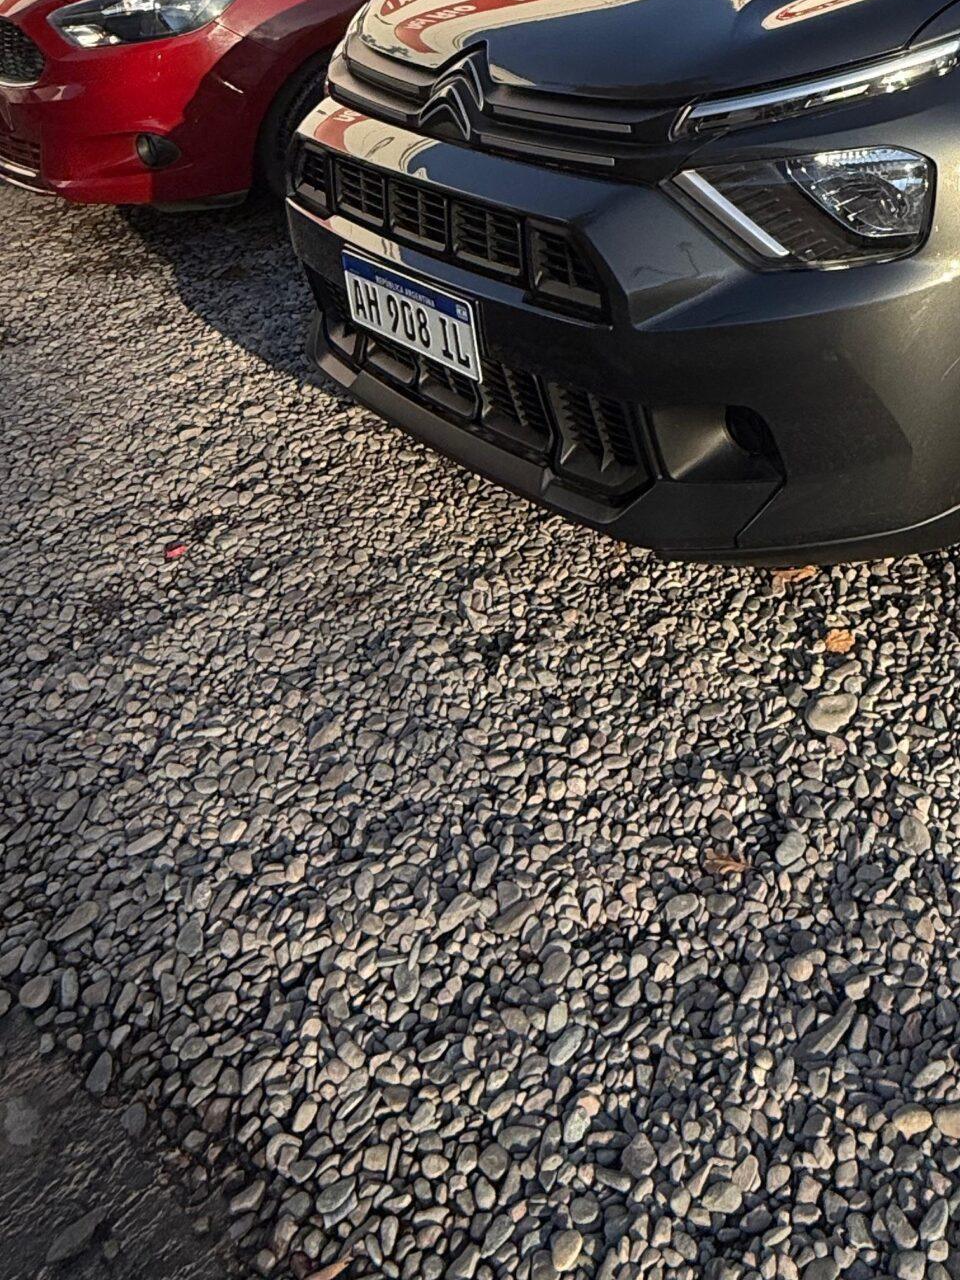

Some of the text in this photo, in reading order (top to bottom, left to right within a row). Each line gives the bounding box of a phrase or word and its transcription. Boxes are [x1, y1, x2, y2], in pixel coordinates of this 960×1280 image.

[352, 279, 471, 369] AH 908 IL
